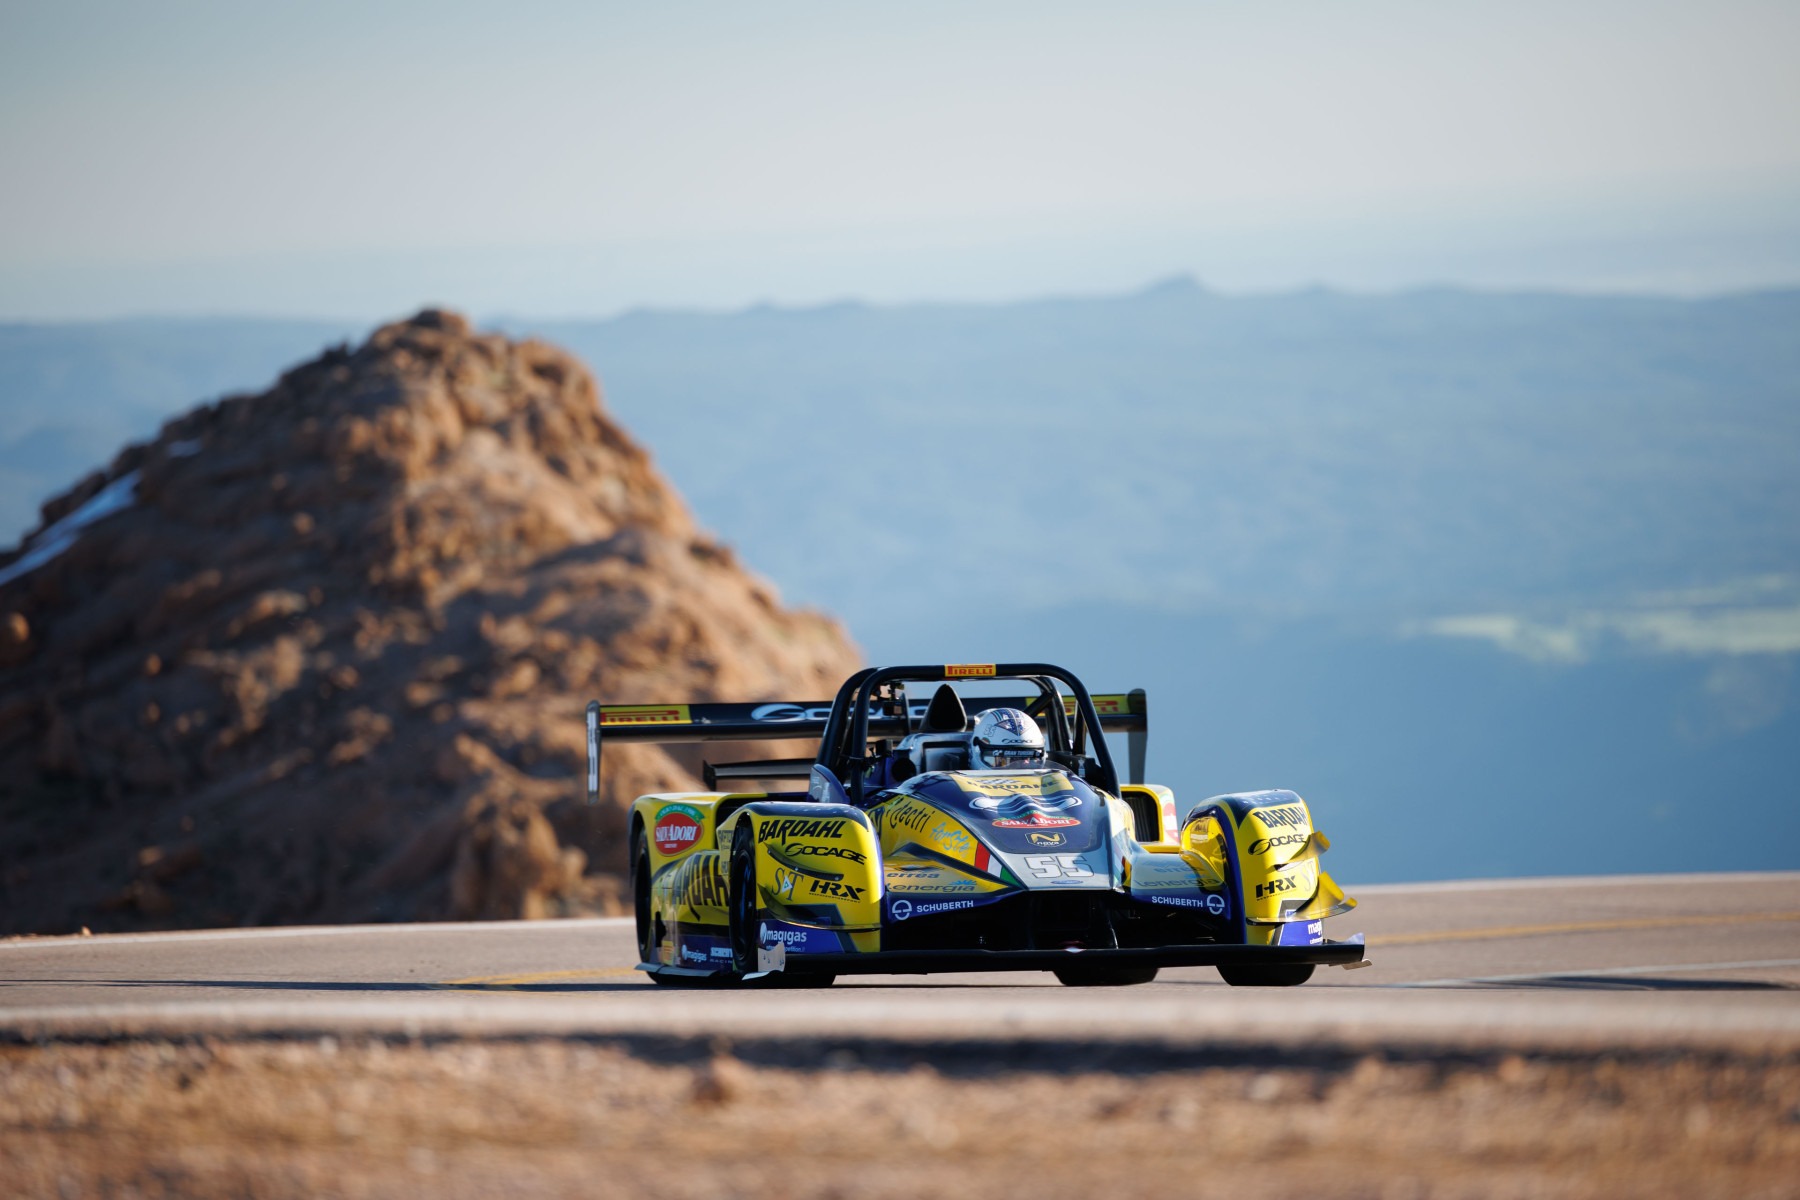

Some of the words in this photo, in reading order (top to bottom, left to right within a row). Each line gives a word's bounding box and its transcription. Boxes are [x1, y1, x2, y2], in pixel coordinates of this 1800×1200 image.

[946, 664, 994, 676] PIRELLI
[600, 710, 680, 723] PIRELLI
[758, 819, 847, 846] BARDAHL
[785, 842, 867, 865] GOCAGE
[1247, 834, 1307, 855] GOCAGE
[1024, 855, 1095, 878] 55
[809, 880, 867, 901] HRX
[1255, 876, 1297, 898] HRX
[916, 900, 974, 913] SCHUBERTH
[1151, 895, 1204, 908] SCHUBERTH
[766, 930, 807, 945] magigas
